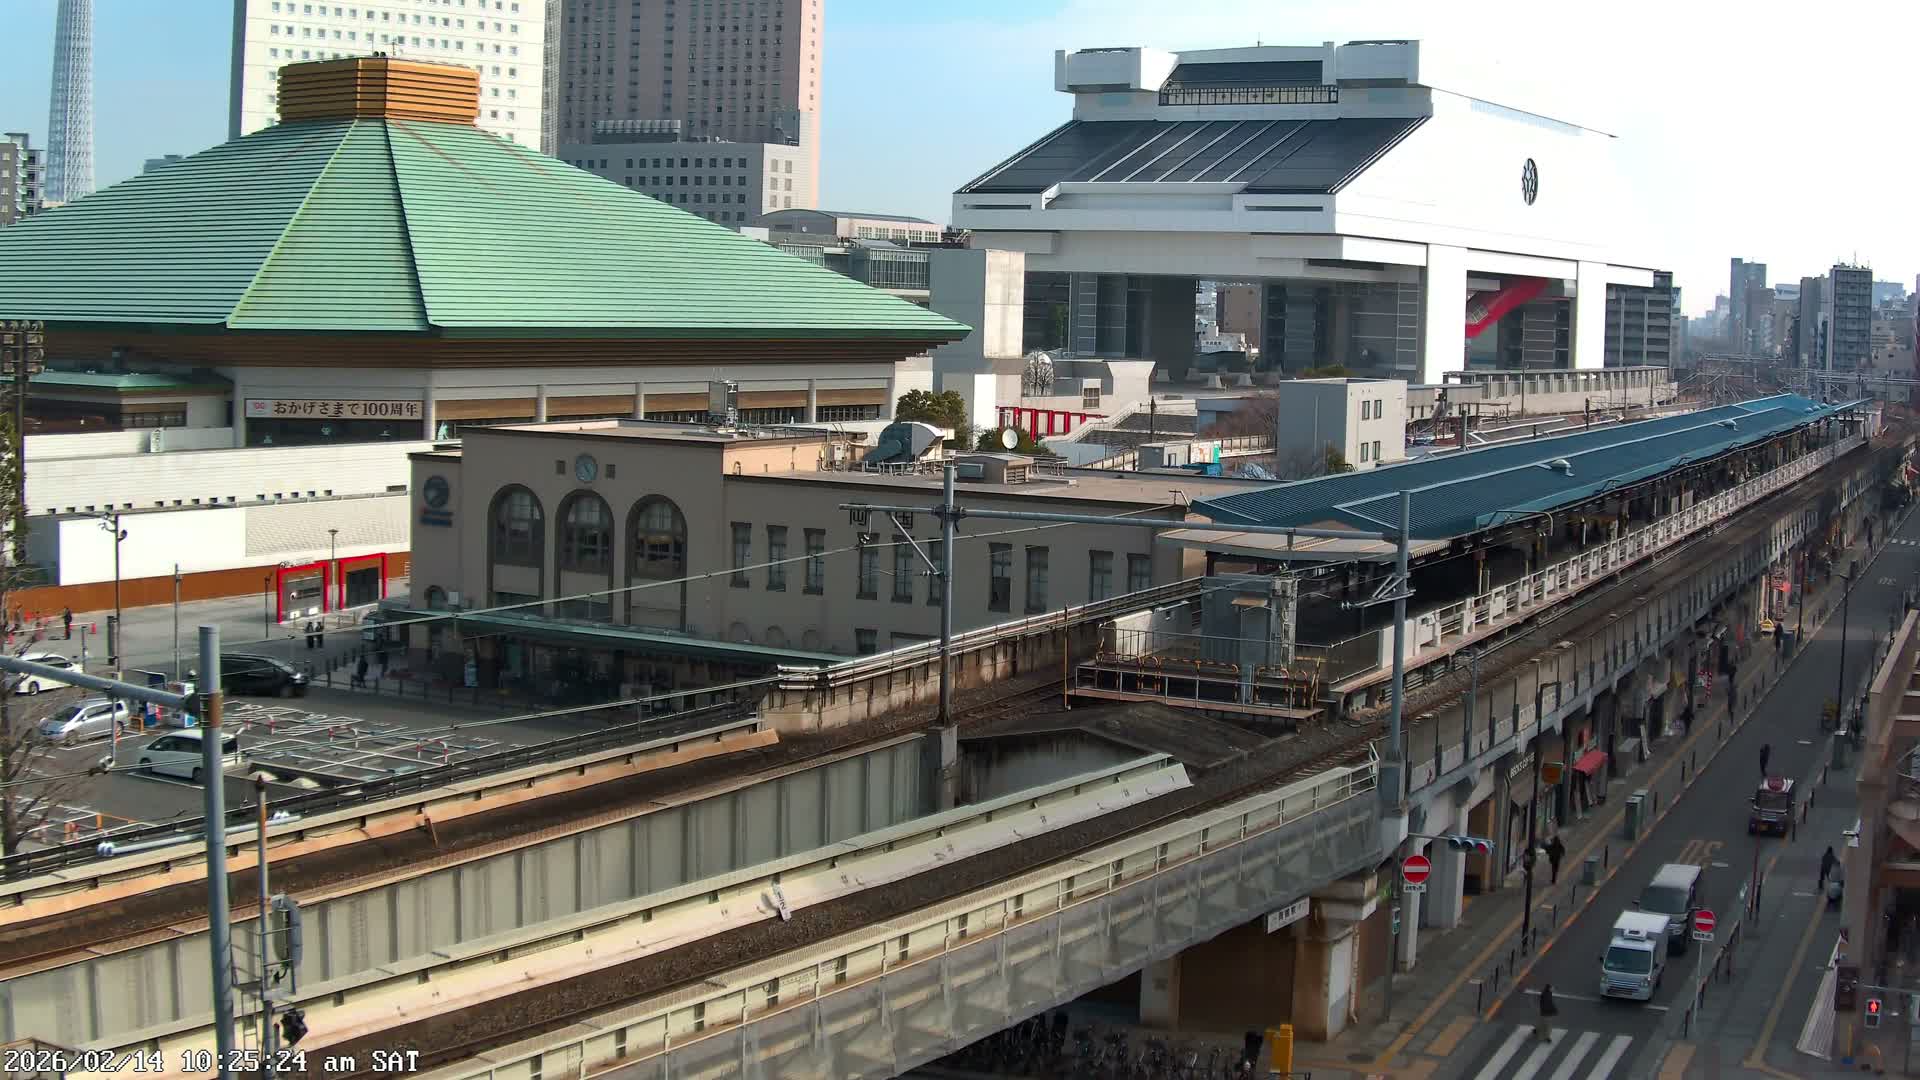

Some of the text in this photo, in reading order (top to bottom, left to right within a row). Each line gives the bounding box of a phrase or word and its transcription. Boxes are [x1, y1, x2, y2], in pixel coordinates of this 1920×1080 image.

[274, 402, 417, 416] おかげさまで100周年
